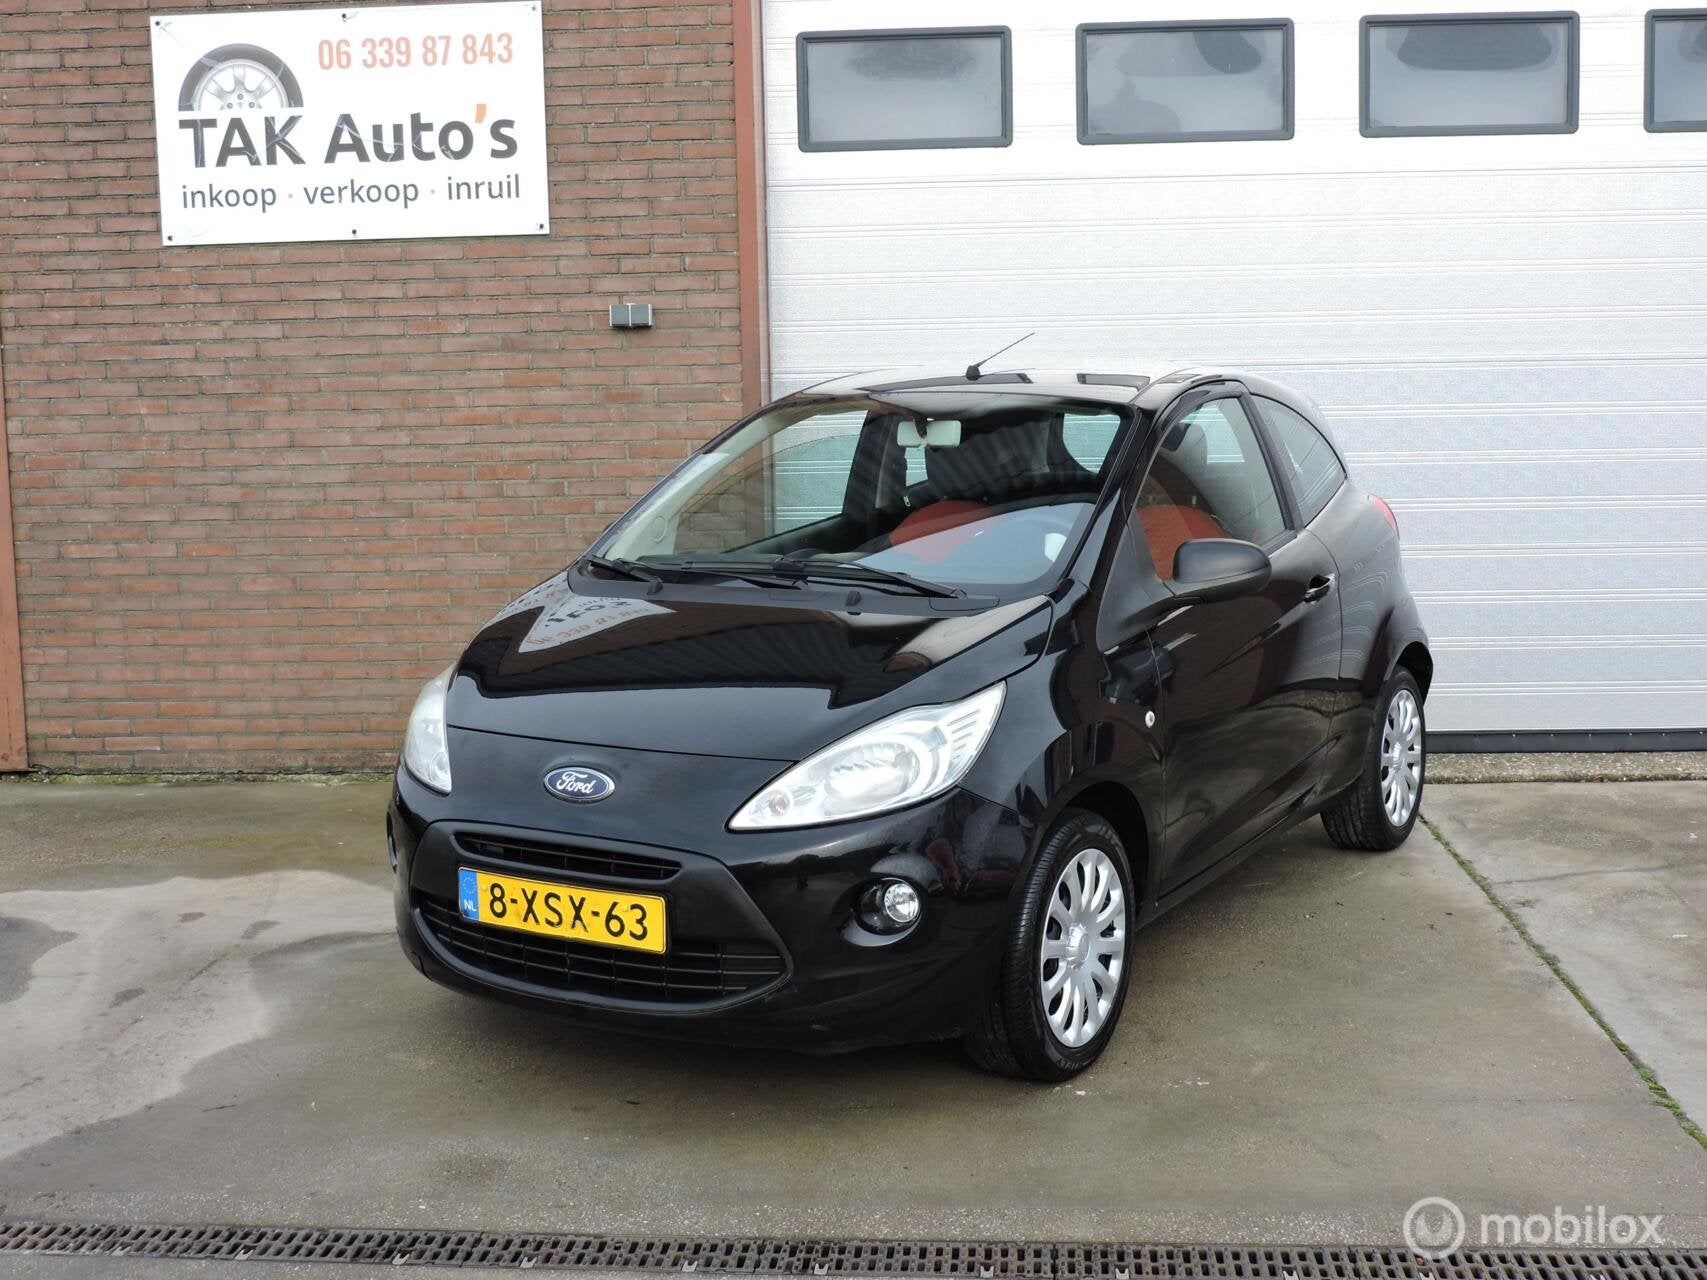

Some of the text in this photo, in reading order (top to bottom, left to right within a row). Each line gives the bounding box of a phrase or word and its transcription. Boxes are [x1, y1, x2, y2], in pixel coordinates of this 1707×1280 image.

[318, 32, 514, 71] 06 339 87 843
[178, 103, 518, 168] TAK Auto's
[182, 175, 520, 213] inkoop verkoop inruil
[556, 771, 594, 793] Ford
[464, 899, 477, 912] NL
[489, 882, 648, 940] 8-XSX-63
